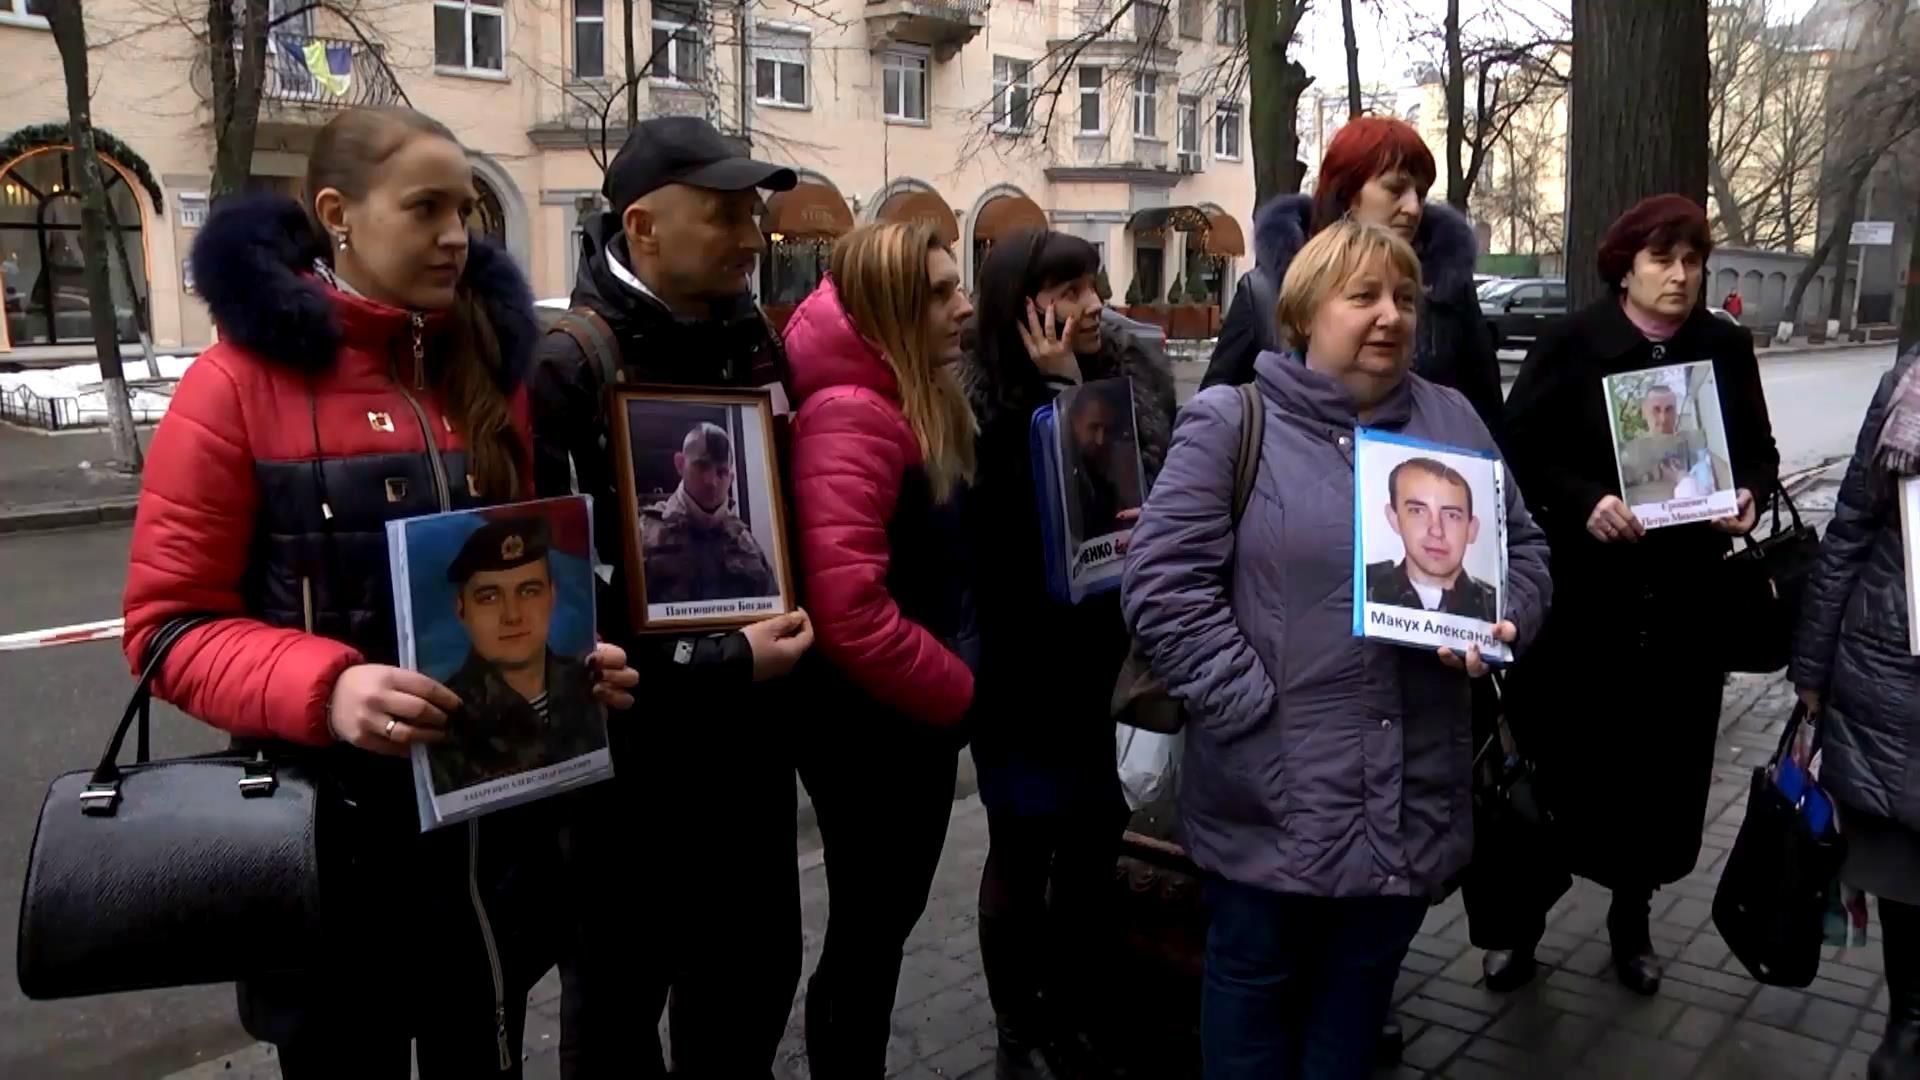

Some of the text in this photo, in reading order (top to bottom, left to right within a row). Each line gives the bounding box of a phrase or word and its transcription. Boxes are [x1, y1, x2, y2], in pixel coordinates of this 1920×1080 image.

[665, 601, 772, 616] Пантюшенко Богдан
[1371, 611, 1420, 632] Макух
